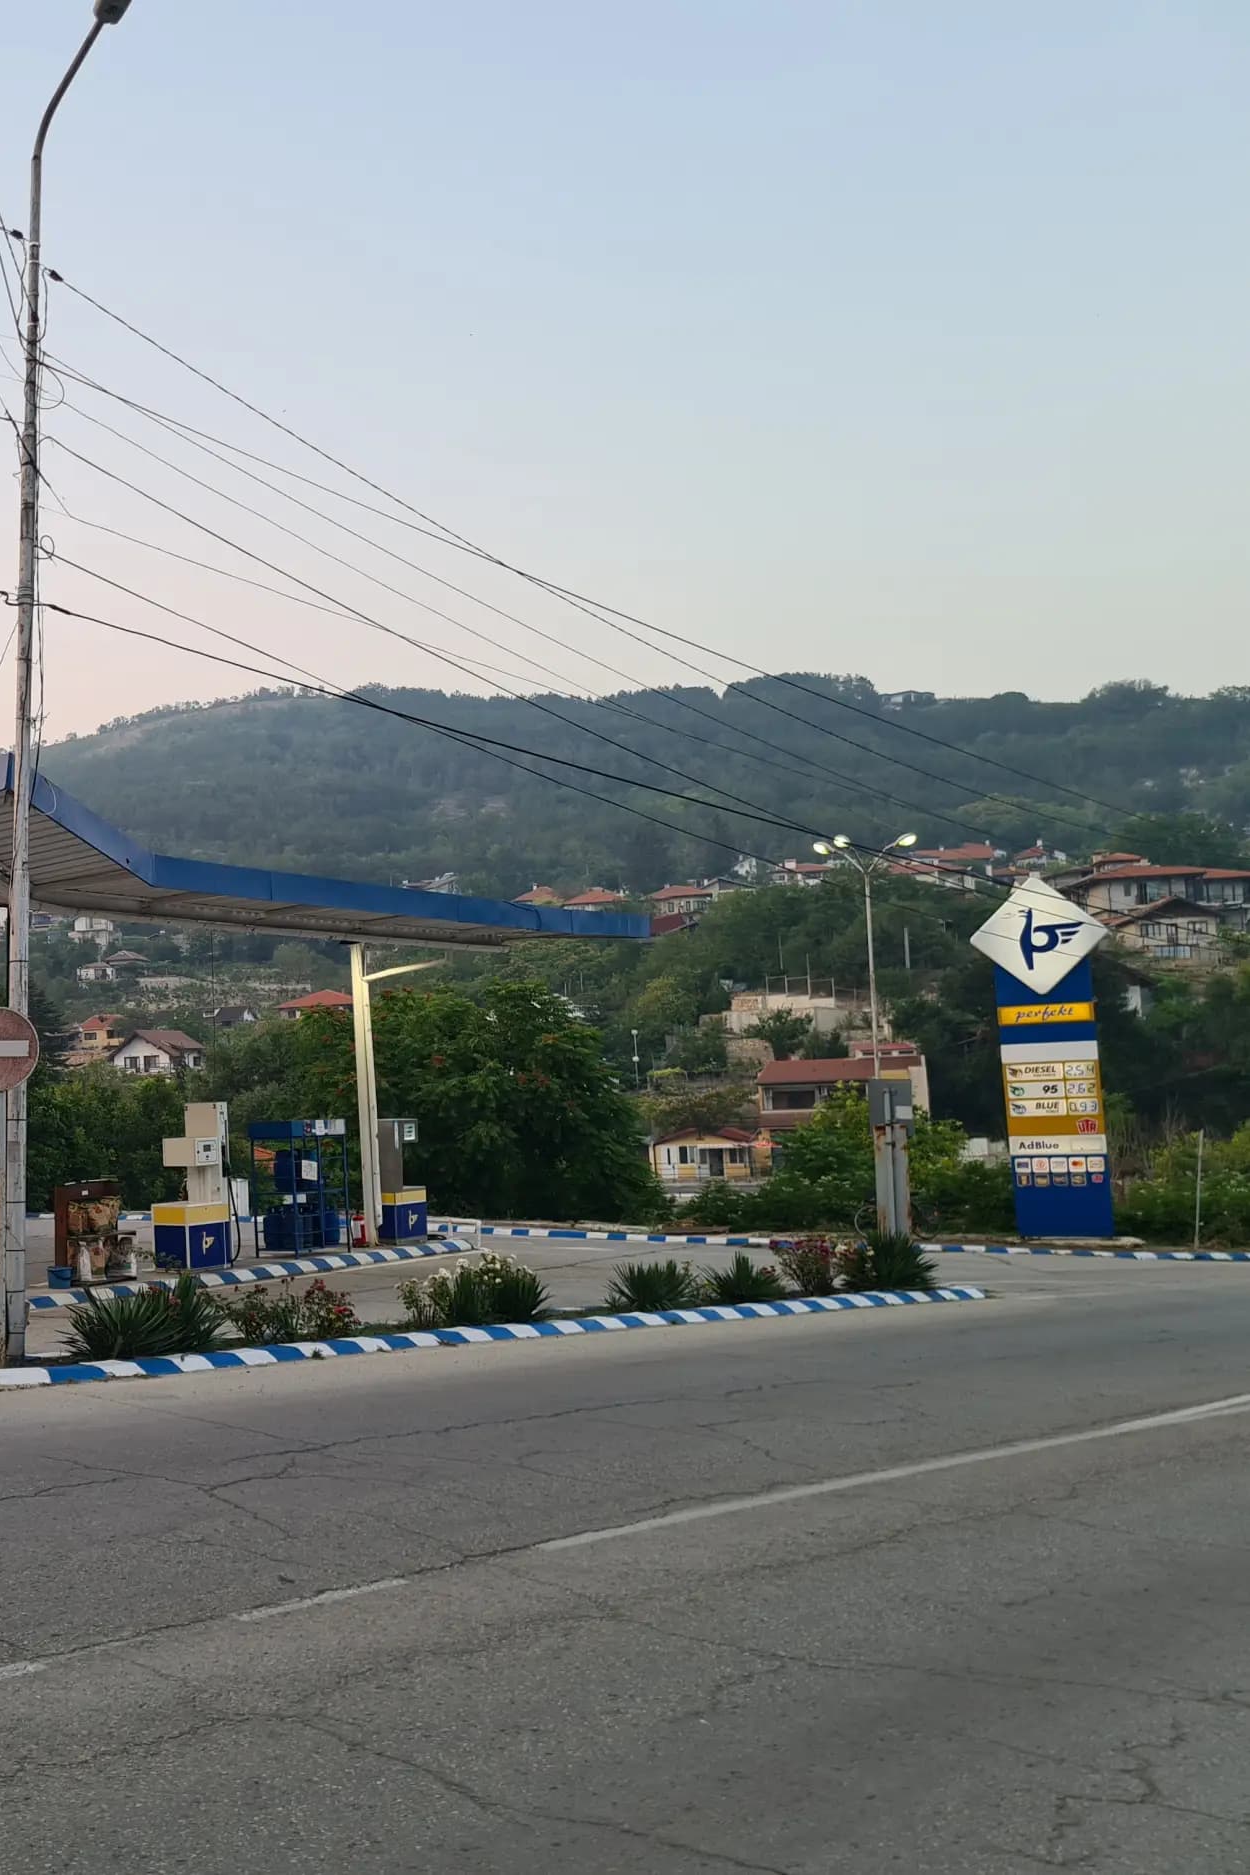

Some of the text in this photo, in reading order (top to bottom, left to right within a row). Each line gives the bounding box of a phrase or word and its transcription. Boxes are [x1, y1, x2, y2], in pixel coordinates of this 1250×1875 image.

[1024, 1065, 1057, 1074] DIESEL
[1042, 1084, 1059, 1095] 95
[1035, 1101, 1060, 1110] BLUE
[1078, 1120, 1097, 1135] UTA
[1018, 1141, 1060, 1150] AdBlue
